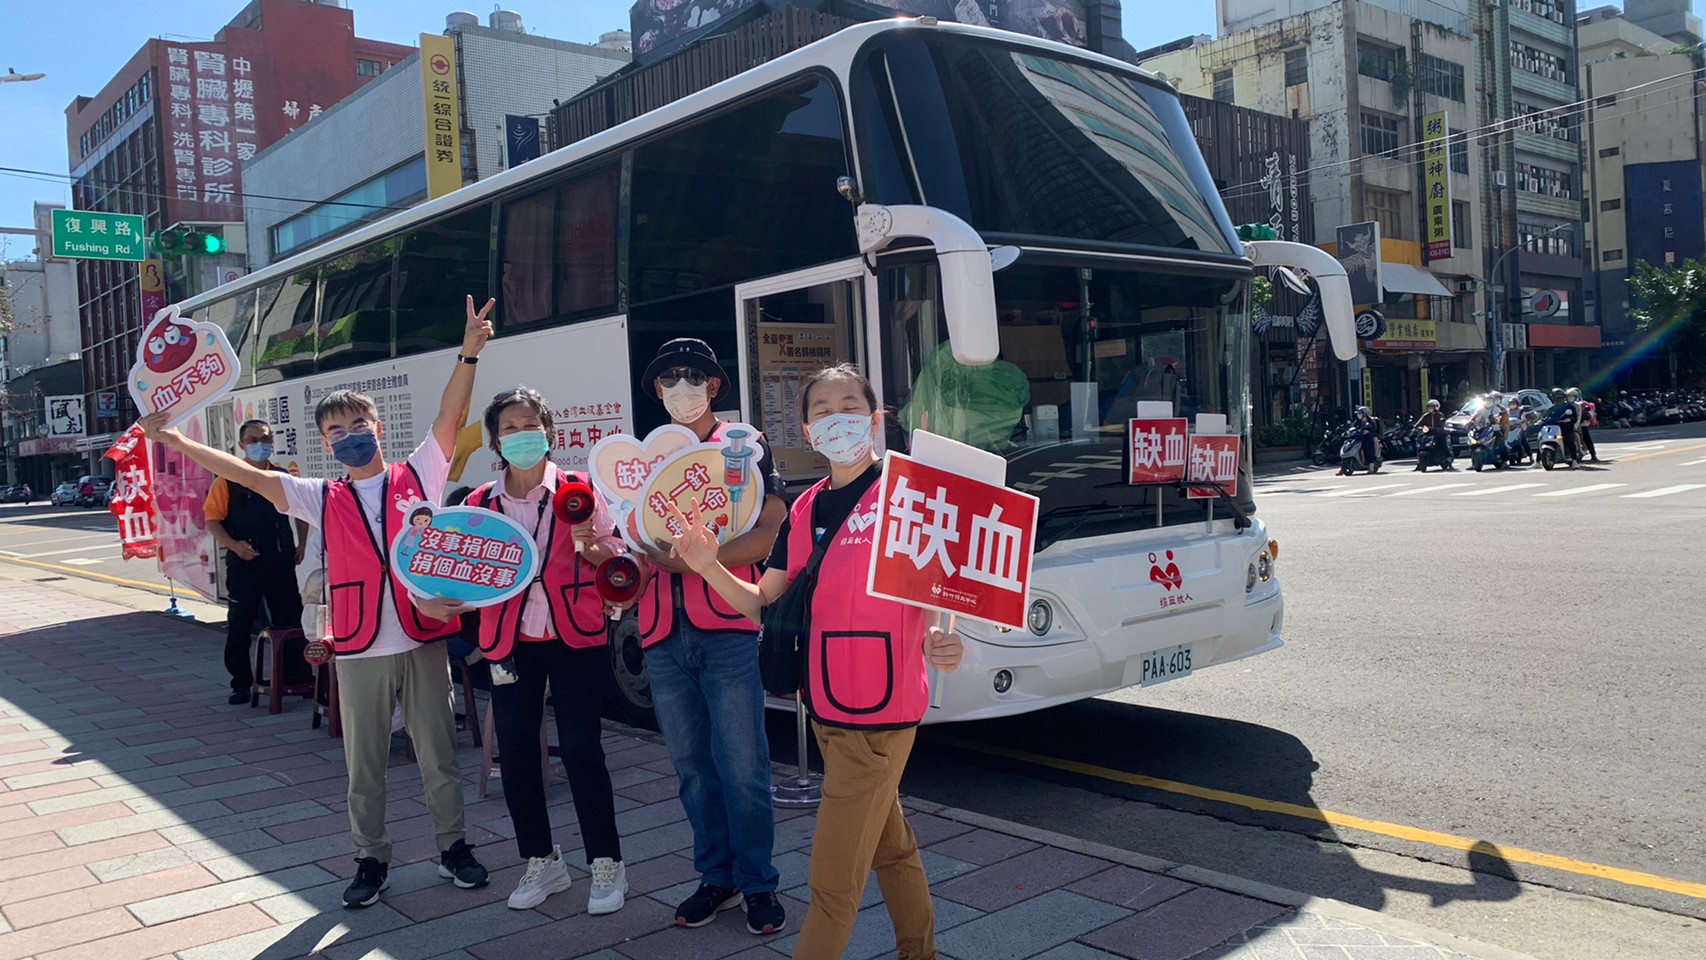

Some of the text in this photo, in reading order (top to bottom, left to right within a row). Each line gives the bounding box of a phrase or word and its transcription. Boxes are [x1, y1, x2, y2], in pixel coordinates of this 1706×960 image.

[194, 50, 234, 204] 腎臟專科診所
[232, 57, 256, 161] 中壢第一家
[432, 79, 454, 163] 統一綜合證券
[65, 217, 131, 236] 復興路
[65, 241, 109, 255] Fushing
[152, 353, 225, 413] 血不夠
[573, 455, 588, 465] Cen
[1135, 427, 1184, 469] 缺血
[1191, 443, 1236, 482] 缺血
[112, 464, 154, 543] 缺血
[419, 528, 523, 564] 沒事捐個血
[885, 475, 1023, 594] 缺血
[409, 551, 517, 588] 捐個血沒事
